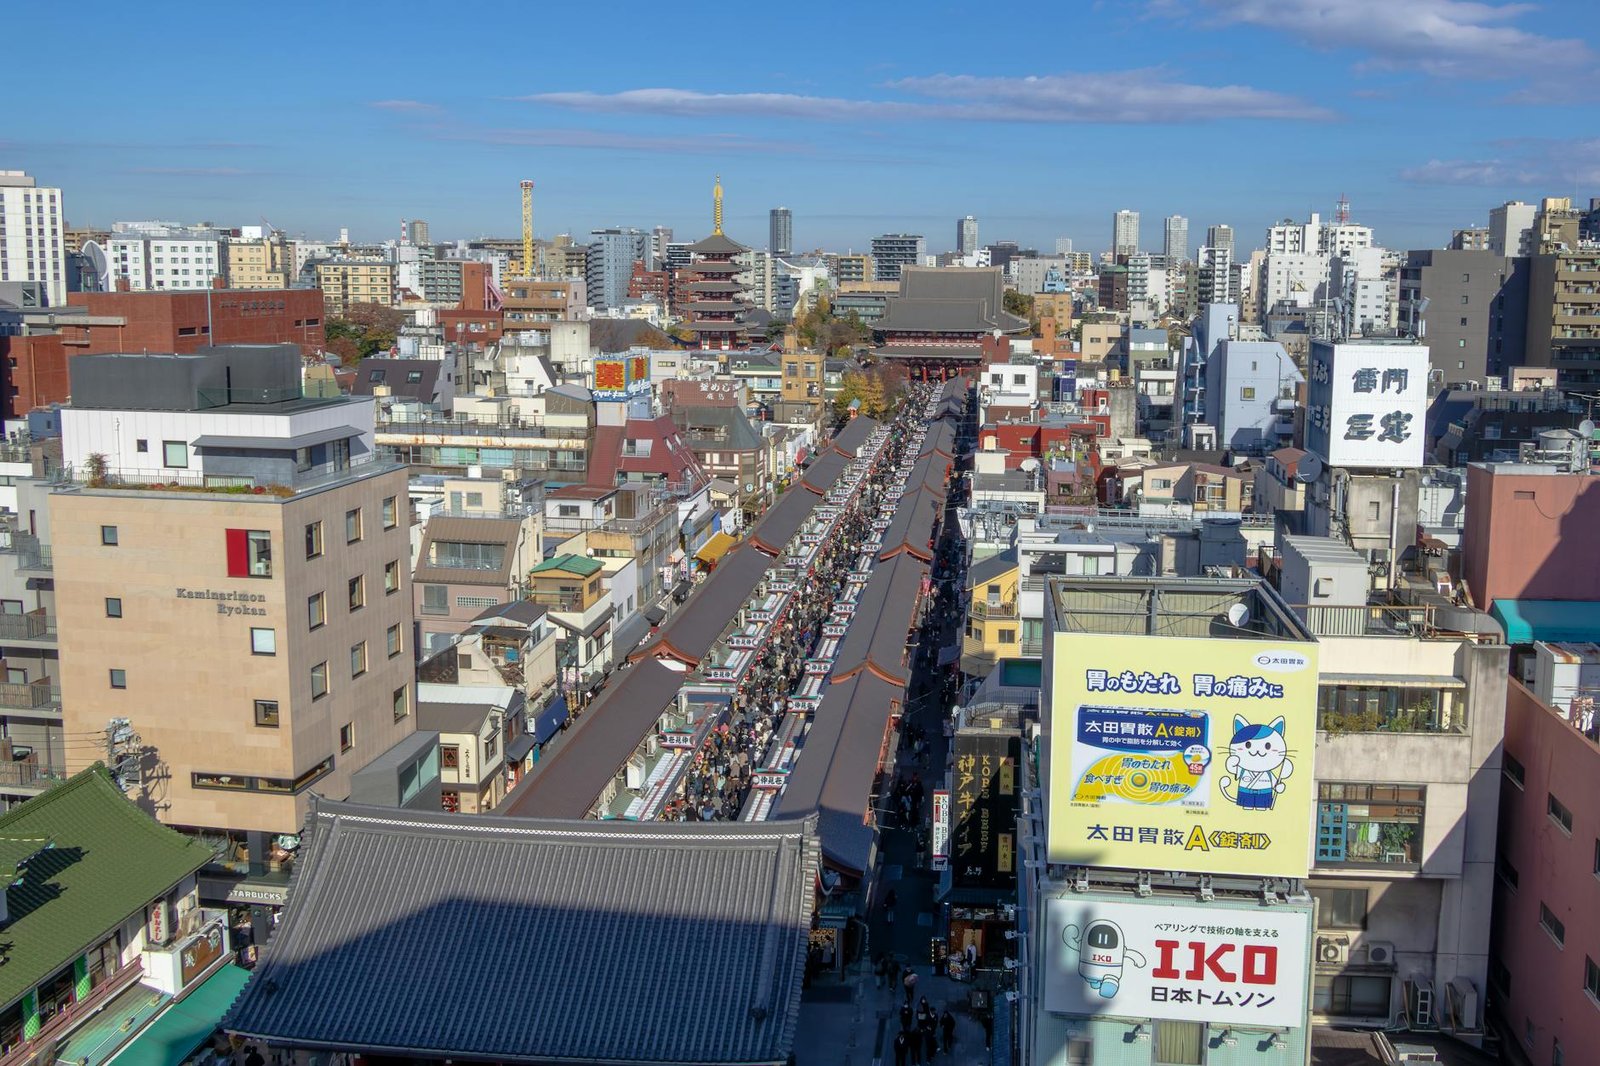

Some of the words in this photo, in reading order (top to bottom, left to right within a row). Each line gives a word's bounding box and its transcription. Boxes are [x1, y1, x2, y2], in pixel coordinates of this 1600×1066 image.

[595, 363, 625, 388] 薬
[1352, 367, 1409, 394] 雷門
[1343, 410, 1414, 444] 三定
[176, 588, 266, 602] Kaminarimon
[217, 604, 267, 617] Ryokan
[1272, 657, 1304, 666] 太田胃散
[1086, 669, 1181, 695] 胃のもたれ
[1193, 674, 1284, 698] 胃の痛みに
[1102, 736, 1182, 747] 胃の中で脂肪を分解して効く
[1121, 757, 1171, 770] 胃のもたれ
[981, 755, 990, 799] KOBE
[1084, 773, 1124, 785] 食べすぎ
[1149, 781, 1193, 793] 胃の痛み
[957, 753, 976, 857] 神戸牛ダイア
[1154, 923, 1279, 938] ベアリングで技術の軸を支える
[1092, 953, 1112, 963] IKO
[1152, 939, 1278, 985] IKO
[1151, 986, 1276, 1008] 日本トムソン
